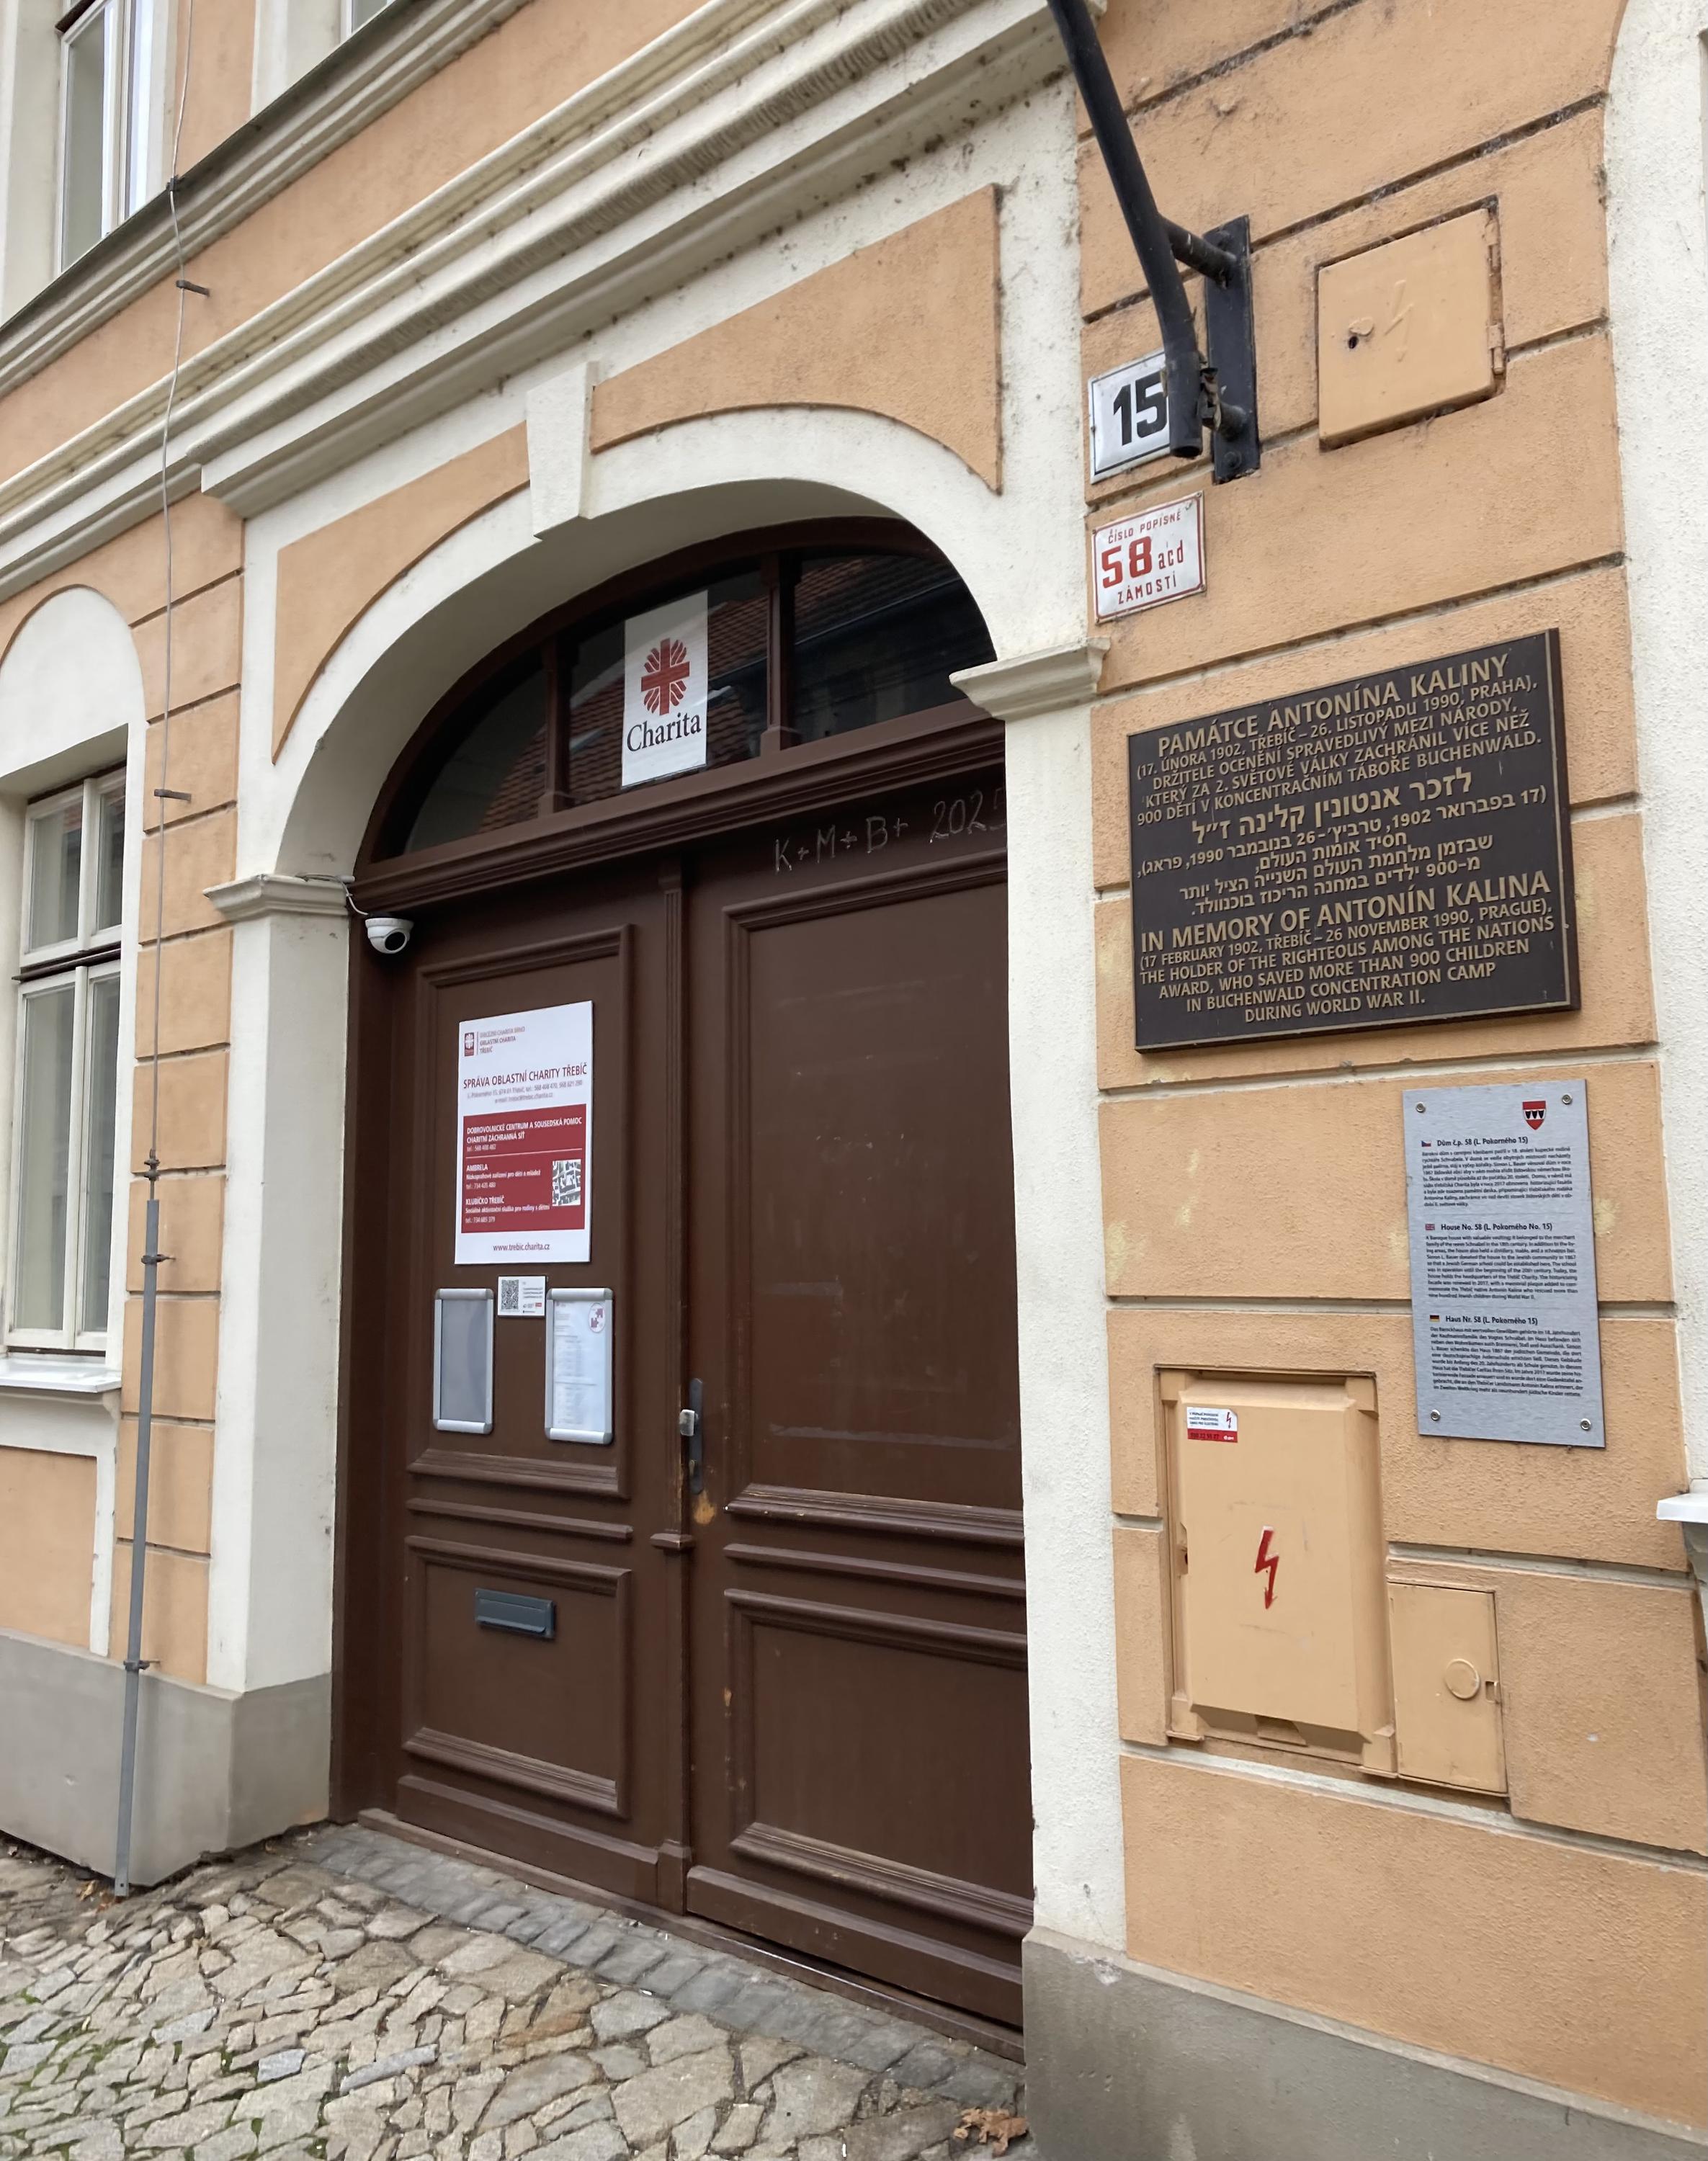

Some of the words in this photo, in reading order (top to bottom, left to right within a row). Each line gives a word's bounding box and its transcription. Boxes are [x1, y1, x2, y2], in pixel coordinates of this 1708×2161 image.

[1113, 372, 1168, 446] 15
[1108, 528, 1134, 544] ČÍSLO
[1140, 511, 1181, 533] POPISNÉ
[1101, 536, 1153, 589] 58
[1158, 540, 1184, 570] acd
[1117, 573, 1178, 605] ZÁMOSTÍ
[627, 712, 701, 753] Charita
[1137, 762, 1158, 781] (17.
[1161, 751, 1207, 773] ÚNORA
[1210, 743, 1246, 761] 1902,
[1248, 729, 1297, 753] TŘEBÍČ
[1310, 722, 1332, 738] 26.
[1336, 701, 1417, 733] LISTOPADU
[1423, 687, 1465, 712] 1990,
[1470, 674, 1537, 702] PRAHA),
[1158, 715, 1258, 758] PAMÁTCE
[1266, 681, 1401, 732] ANTONÍNA
[1410, 653, 1508, 698] KALINY
[1145, 784, 1188, 808] KTERÝ
[1191, 782, 1211, 799] ZA
[1215, 779, 1229, 793] 2.
[1232, 761, 1295, 789] SVĚTOVÉ
[1300, 751, 1349, 774] VÁLKY
[1354, 731, 1447, 764] ZACHRÁNIL
[1452, 721, 1490, 741] VÍCE
[1495, 709, 1530, 733] NEŽ
[1153, 764, 1215, 790] DRŽITELE
[1219, 746, 1282, 775] OCENĚNÍ
[1286, 722, 1388, 761] SPRAVEDLIVÝ
[1394, 715, 1434, 737] MEZI
[1440, 697, 1517, 727] NÁRODY,
[1137, 809, 1162, 826] 900
[1166, 798, 1196, 820] DĚTÍ
[1200, 798, 1210, 813] V
[1215, 770, 1343, 810] KONCENTRAČNÍM
[1346, 755, 1410, 782] TÁBOŘE
[1416, 730, 1542, 768] BUCHENWALD.
[1140, 954, 1157, 971] (17
[1161, 944, 1225, 965] FEBRUARY
[1228, 940, 1263, 956] 1902,
[1265, 929, 1312, 951] TŘEBÍČ
[1325, 927, 1343, 943] 26
[1347, 916, 1430, 939] NOVEMBER
[1433, 909, 1475, 927] 1990,
[1479, 898, 1552, 921] PRAGUE),
[1141, 930, 1163, 953] IN
[1172, 912, 1274, 948] MEMORY
[1280, 907, 1310, 932] OF
[1316, 883, 1435, 927] ANTONÍN
[1447, 869, 1552, 908] KALINA
[1139, 968, 1165, 985] THE
[1170, 961, 1224, 981] HOLDER
[1228, 957, 1246, 973] OF
[1248, 954, 1276, 970] THE
[1282, 941, 1367, 966] RIGHTEOUS
[1371, 931, 1434, 954] AMONG
[1438, 926, 1471, 945] THE
[1477, 915, 1555, 940] NATIONS
[1158, 980, 1214, 999] AWARD,
[1218, 974, 1253, 991] WHO
[1258, 968, 1304, 986] SAVED
[1309, 961, 1354, 980] MORE
[1358, 954, 1403, 974] THAN
[1409, 949, 1440, 967] 900
[1445, 938, 1529, 962] CHILDREN
[1186, 997, 1202, 1012] IN
[1207, 985, 1305, 1010] BUCHENWALD
[1310, 968, 1441, 997] CONCENTRATION
[1447, 962, 1496, 981] CAMP
[1245, 1003, 1302, 1023] DURING
[1305, 996, 1362, 1016] WORLD
[1366, 991, 1405, 1009] WAR
[1409, 989, 1426, 1005] II.
[463, 1074, 490, 1088] SPRÁVA
[492, 1070, 527, 1086] OBLASTNÍ
[529, 1068, 559, 1081] CHARITY
[563, 1062, 586, 1077] TŘEBÍČ
[467, 1124, 504, 1135] DOBROVOLNICKÉ
[506, 1122, 528, 1131] CENTRUM
[535, 1118, 562, 1128] SOUSEDSKÁ
[493, 1242, 550, 1251] www.trebic.charita.cz
